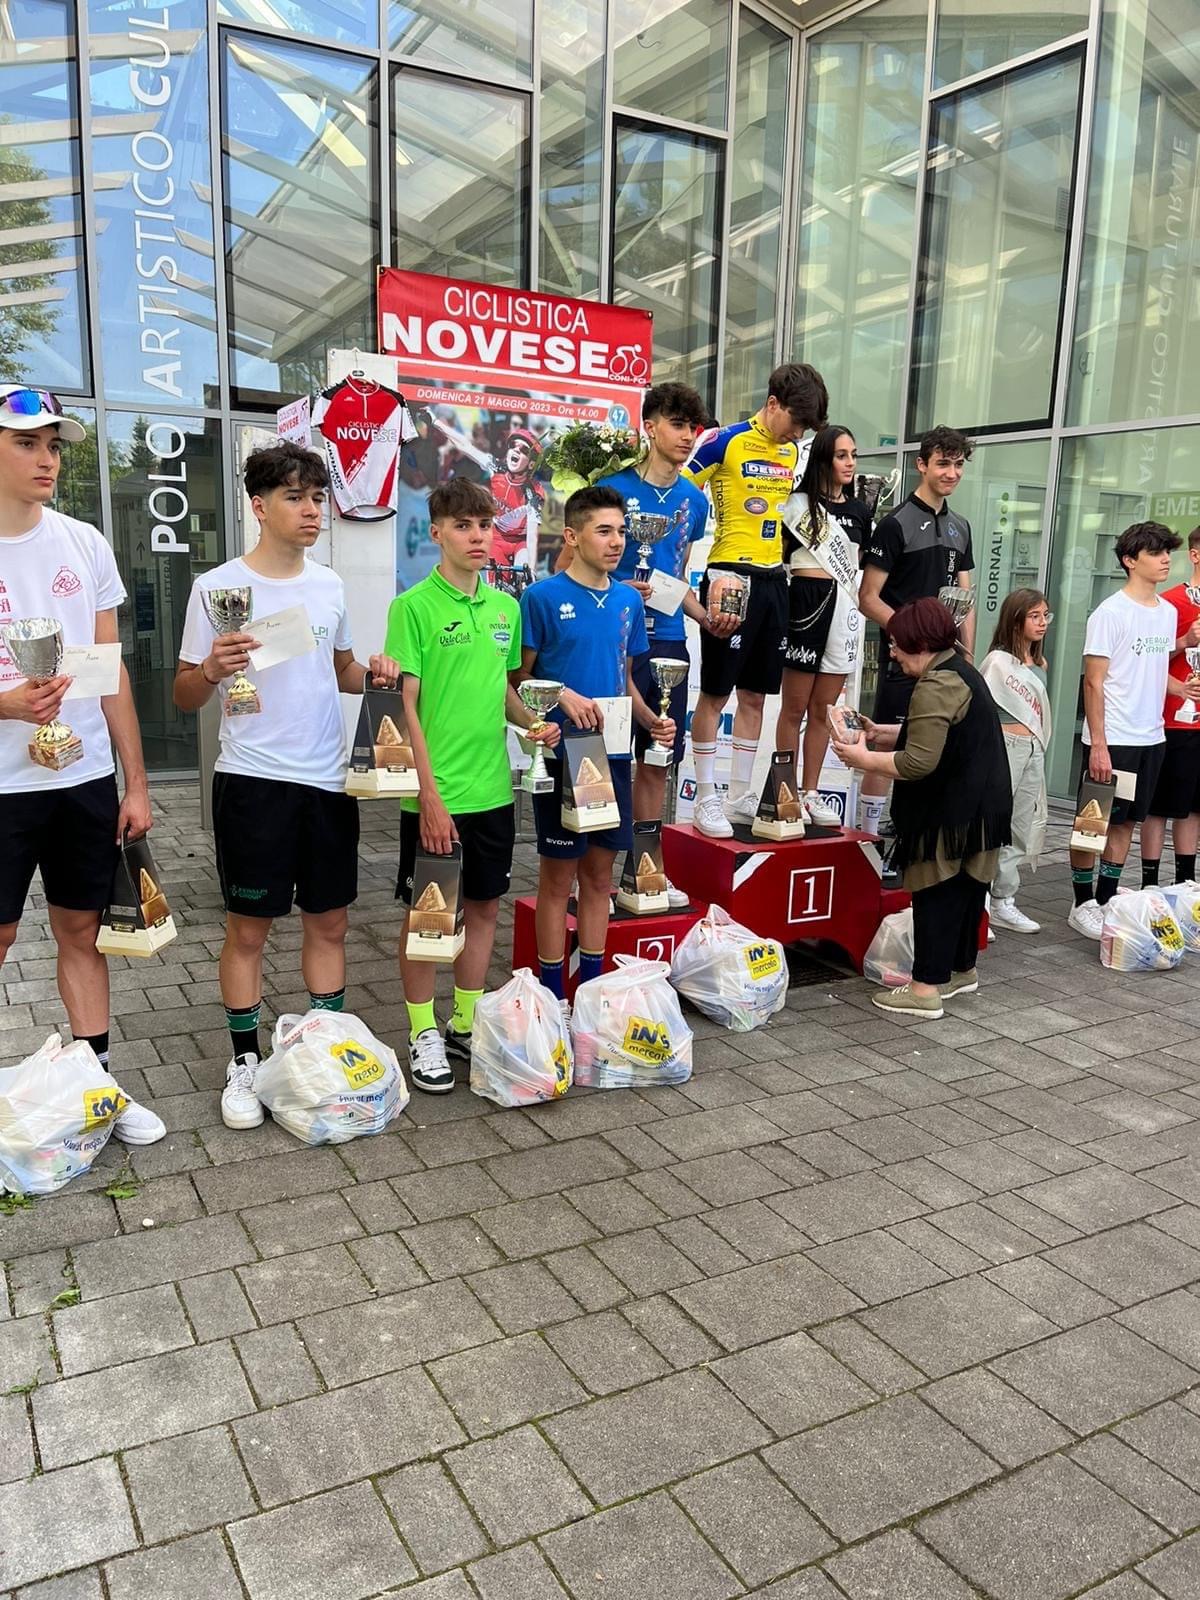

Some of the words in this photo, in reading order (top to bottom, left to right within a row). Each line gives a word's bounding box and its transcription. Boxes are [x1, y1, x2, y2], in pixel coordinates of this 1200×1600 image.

[128, 7, 173, 106] CUL
[131, 131, 184, 399] ARTISTICO
[443, 287, 589, 335] CICLISTICA
[381, 312, 609, 379] NOVESE
[416, 388, 472, 404] DOMENICA
[474, 395, 485, 405] 21
[487, 396, 528, 410] MAGGIO
[530, 401, 551, 412] 2023
[558, 405, 574, 416] Ore
[576, 408, 599, 418] 14.00
[611, 410, 625, 422] 47
[336, 427, 397, 442] NOVESE
[347, 420, 384, 430] CICLISTICA
[146, 420, 190, 553] POLO
[827, 556, 848, 585] NOVESE
[986, 531, 1003, 612] GIORNALI
[802, 875, 818, 914] 1
[646, 940, 665, 962] 2
[752, 960, 777, 974] mercato
[628, 1045, 667, 1061] mercat
